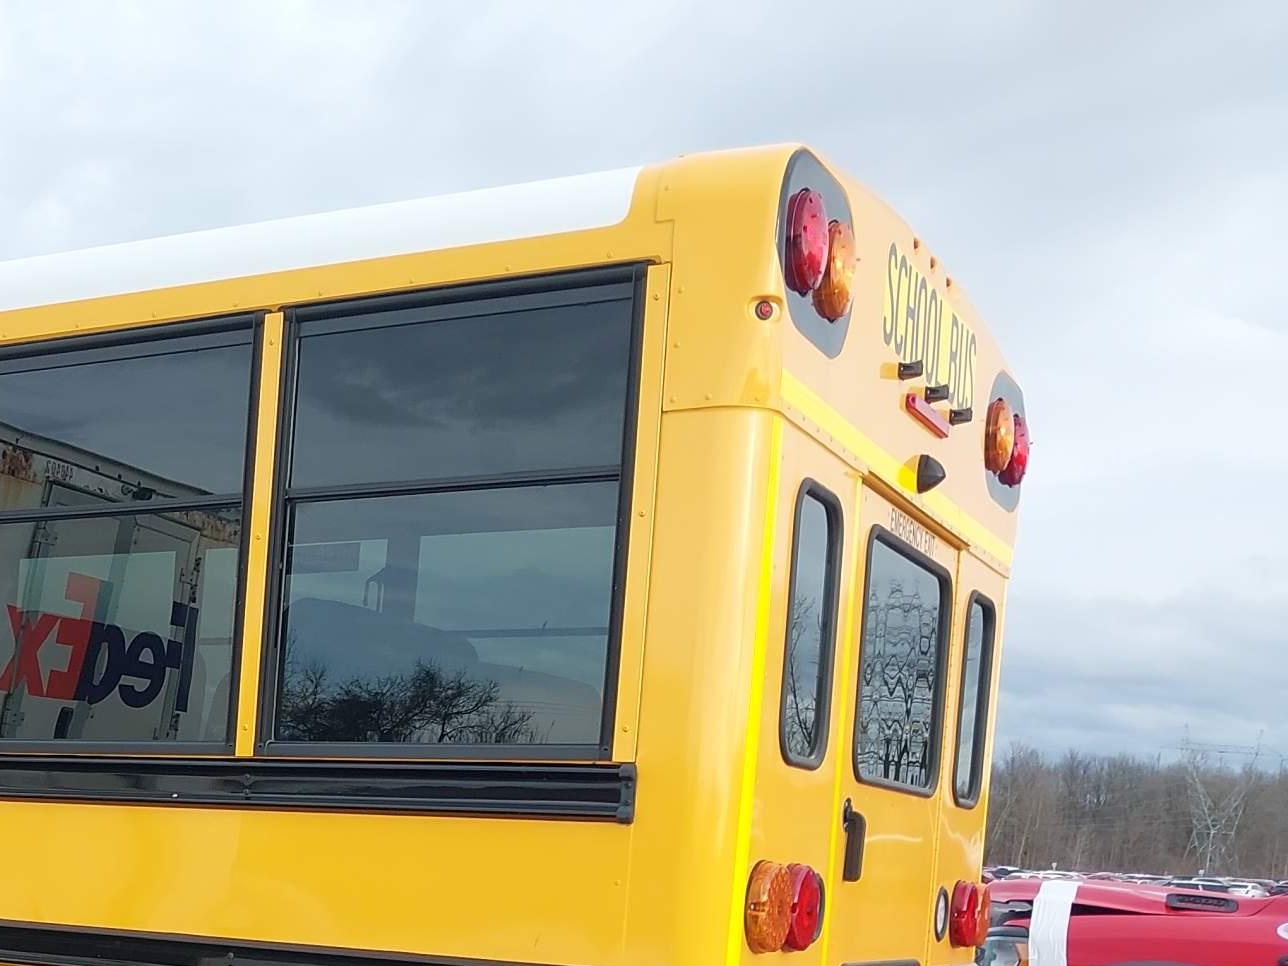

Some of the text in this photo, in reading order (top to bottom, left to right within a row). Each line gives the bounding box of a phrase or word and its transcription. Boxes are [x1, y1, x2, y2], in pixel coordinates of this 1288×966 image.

[883, 242, 977, 409] SCHOOL BUS
[890, 508, 937, 557] EMERGENCY EXIT
